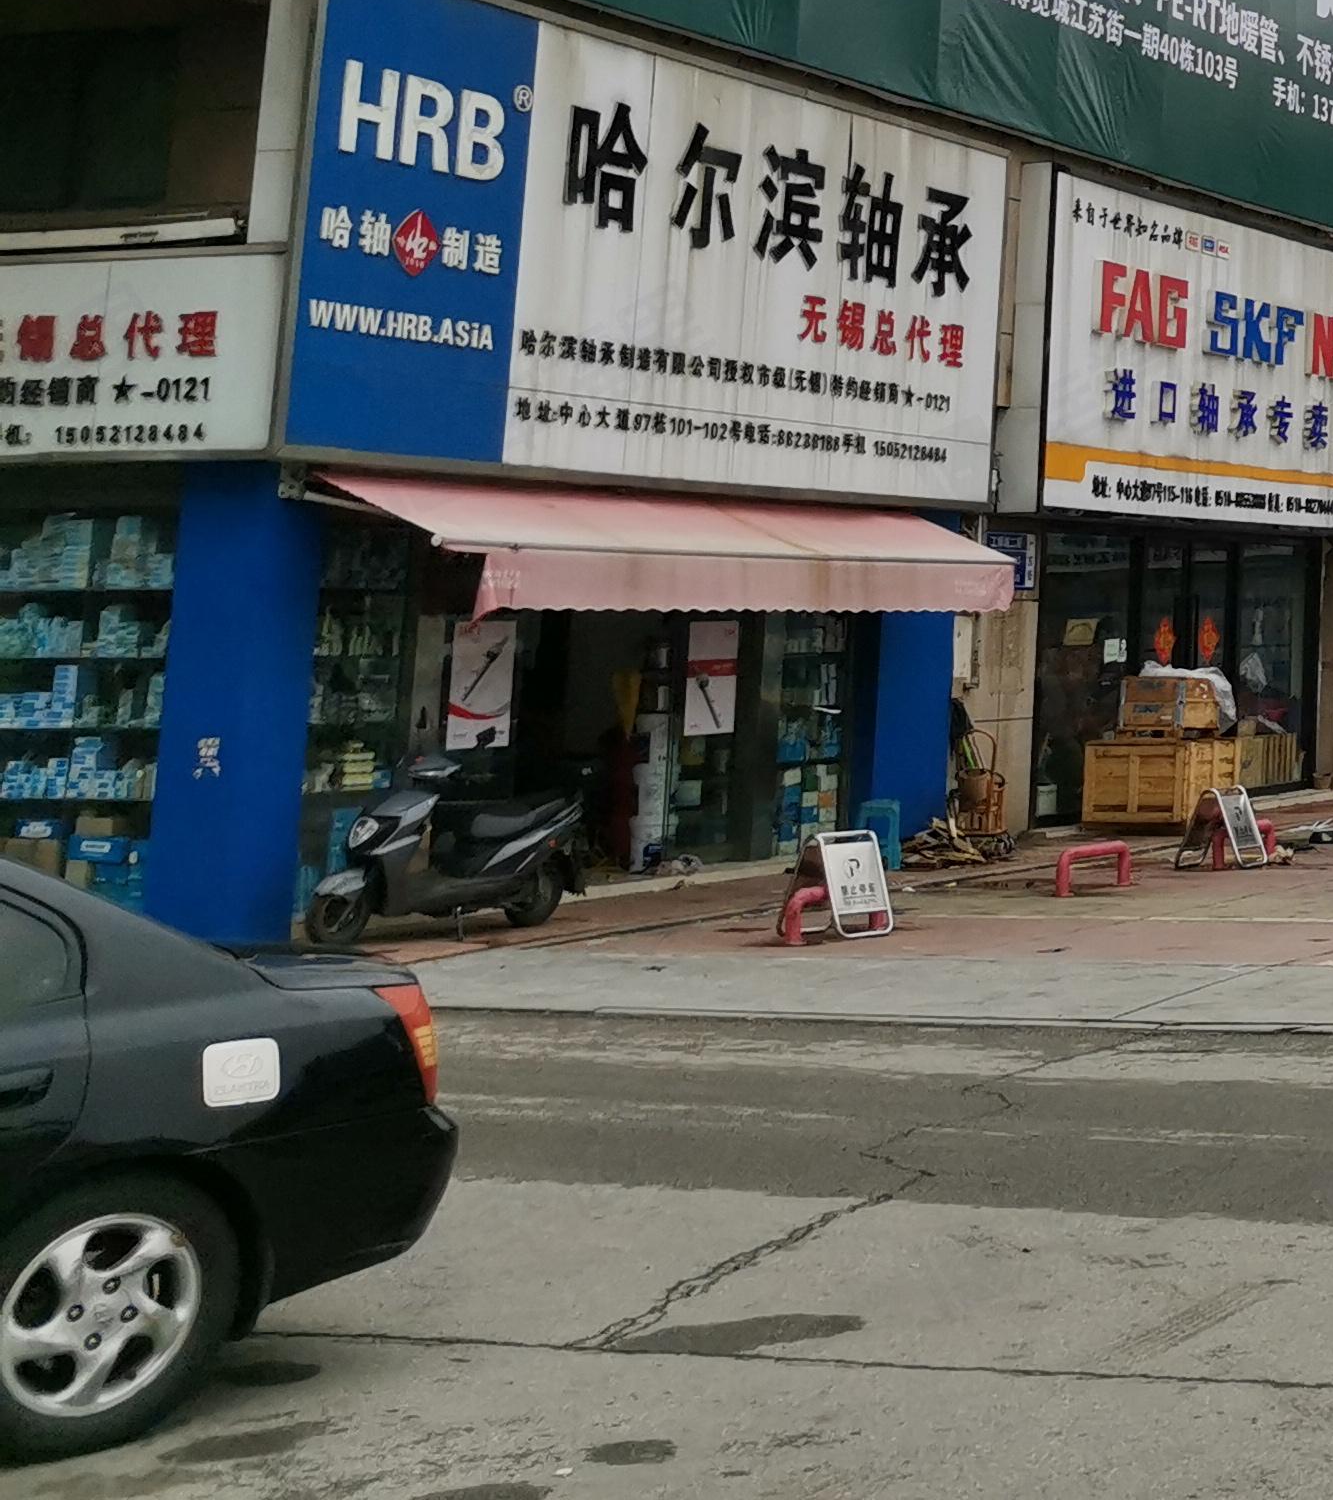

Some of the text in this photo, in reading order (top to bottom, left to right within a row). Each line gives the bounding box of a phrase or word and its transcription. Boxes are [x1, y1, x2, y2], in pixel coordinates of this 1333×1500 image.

[338, 59, 506, 182] HRB
[563, 101, 972, 299] 哈尔滨轴承
[798, 294, 965, 369] 无锡总代理
[1098, 260, 1190, 350] FAG
[1205, 290, 1304, 366] SKF
